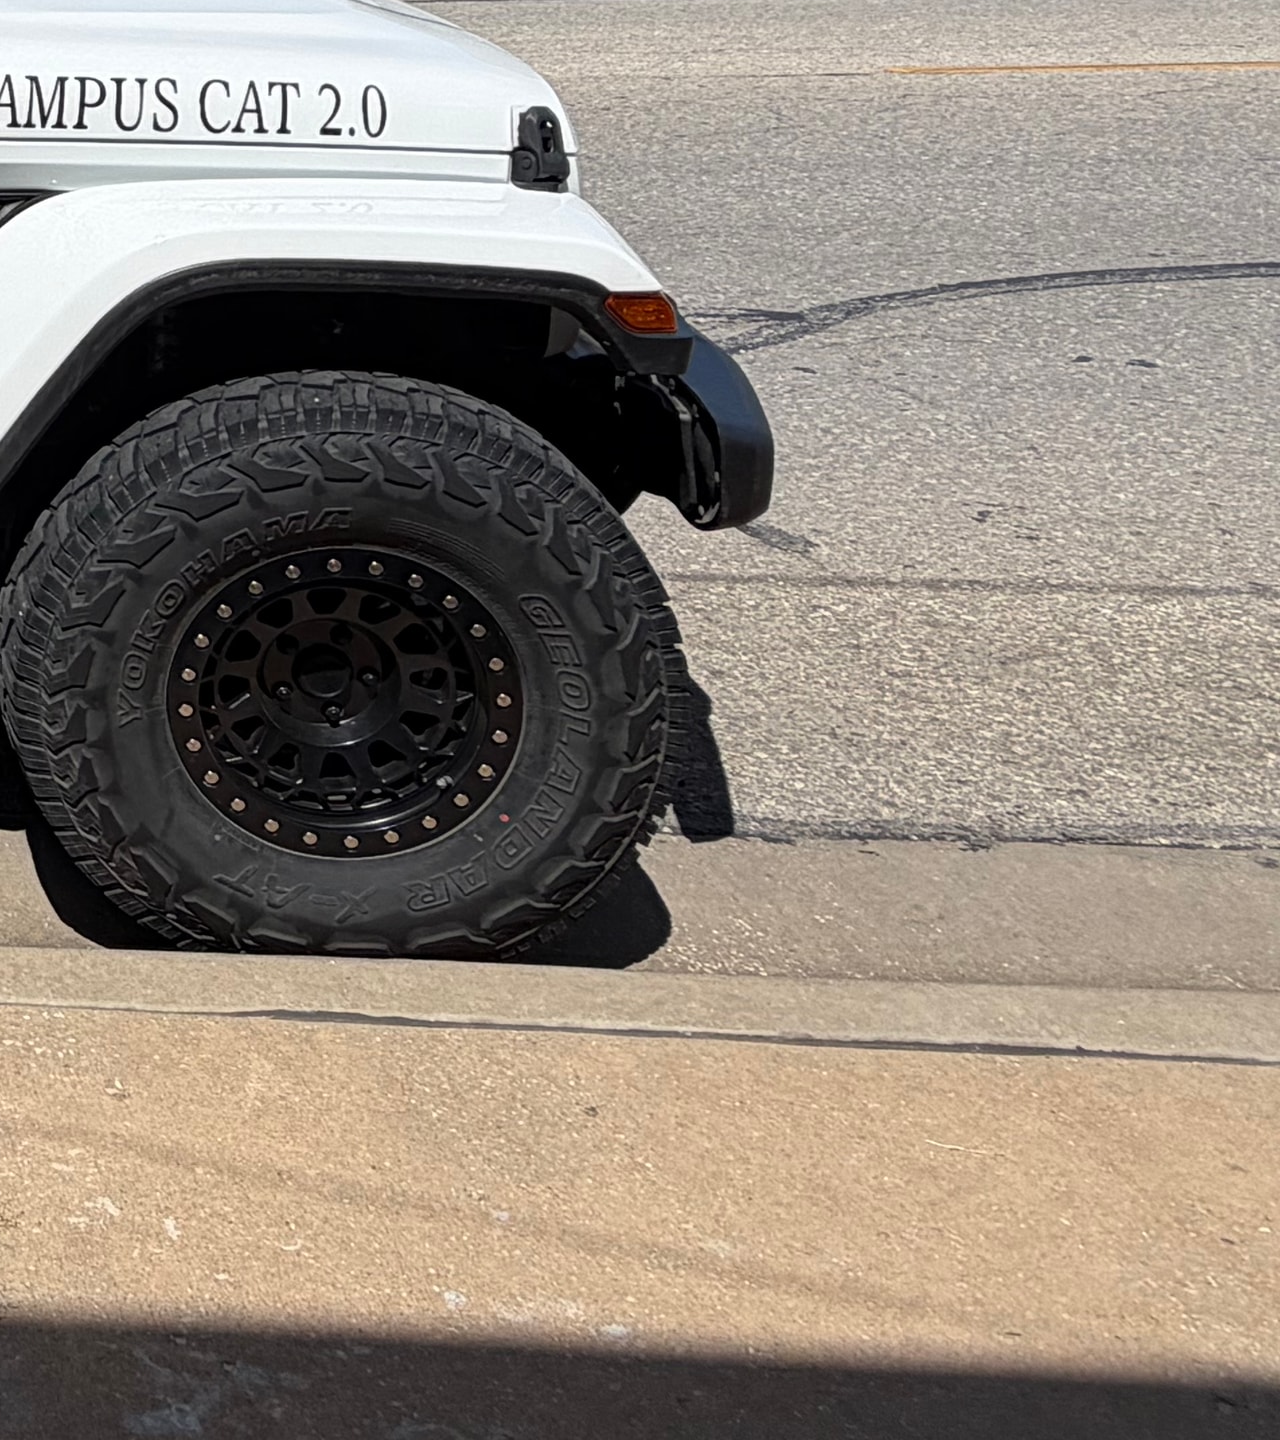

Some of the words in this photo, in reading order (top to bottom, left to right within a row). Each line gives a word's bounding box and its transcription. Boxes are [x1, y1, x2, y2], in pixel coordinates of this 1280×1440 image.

[198, 78, 301, 135] CAT
[317, 82, 388, 138] 2.0
[117, 507, 352, 729] YOKOHAMA
[401, 593, 591, 912] GEOLANDAR
